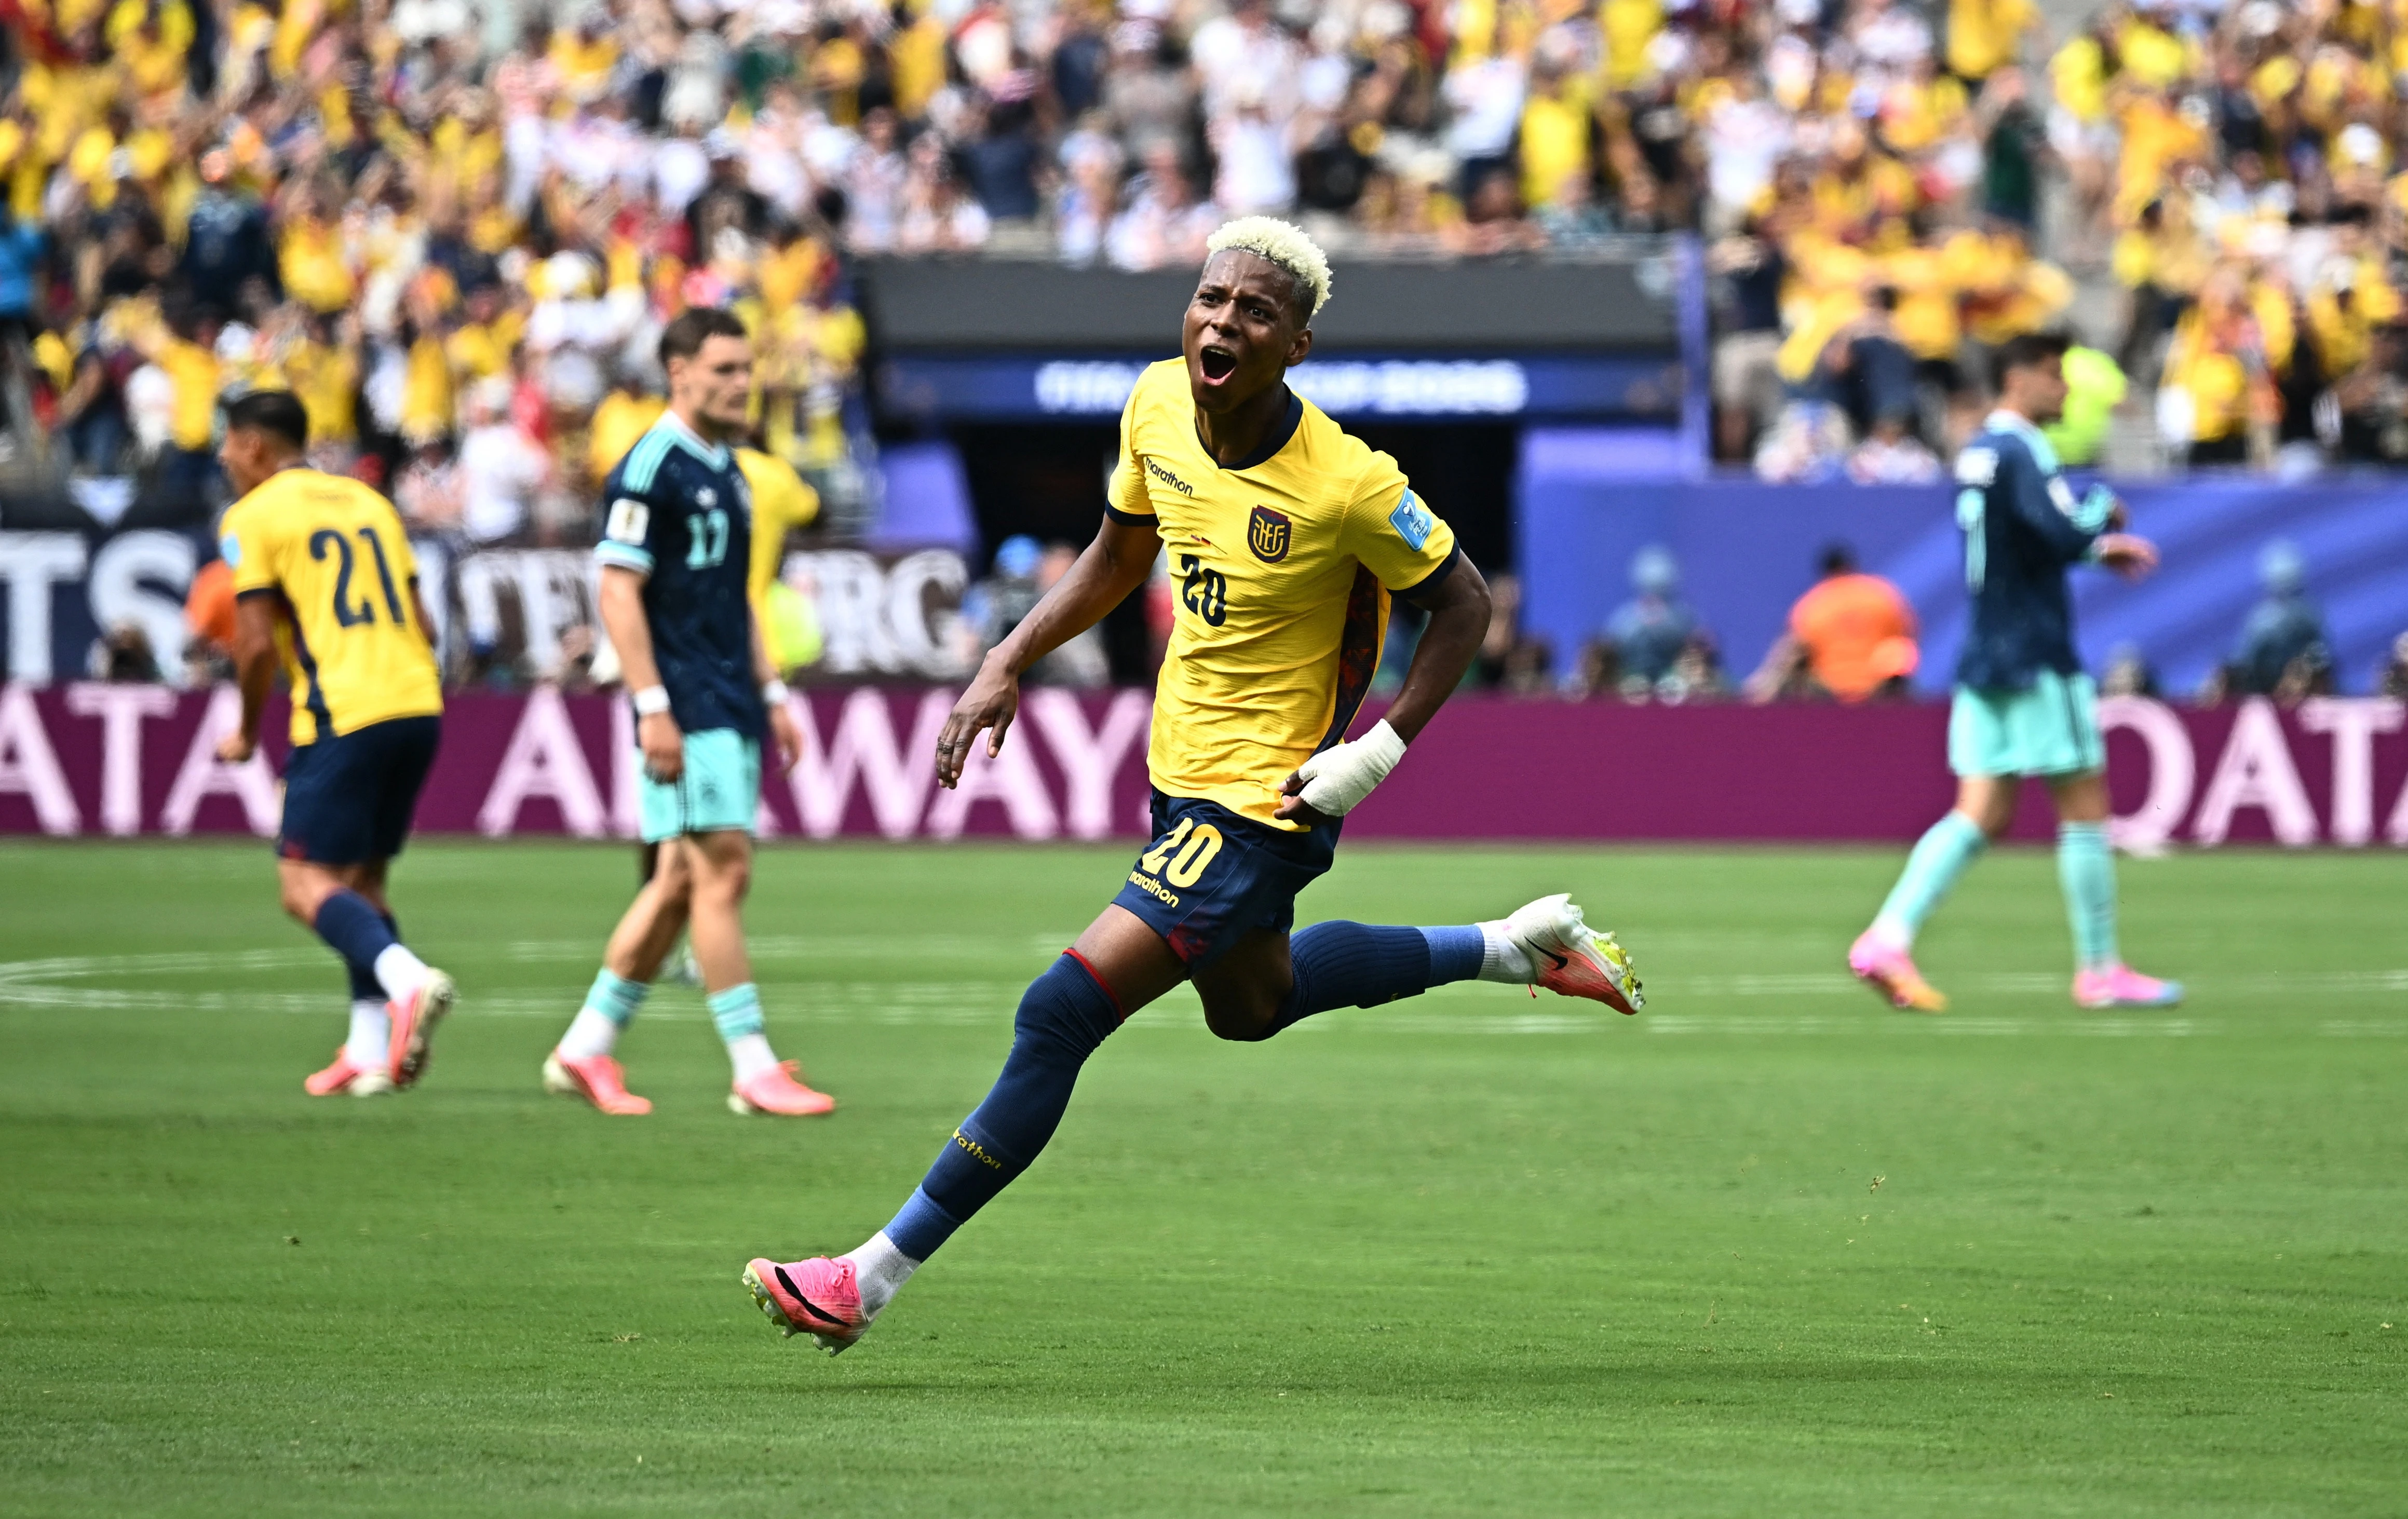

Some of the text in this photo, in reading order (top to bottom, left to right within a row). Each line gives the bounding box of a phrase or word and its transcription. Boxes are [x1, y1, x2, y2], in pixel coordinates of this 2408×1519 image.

[1145, 456, 1193, 497] marathon
[309, 528, 405, 627] 21
[1181, 554, 1227, 627] 20
[0, 679, 1153, 839] ATA AIWAY
[1142, 818, 1223, 887] 20
[1128, 871, 1179, 908] marathon
